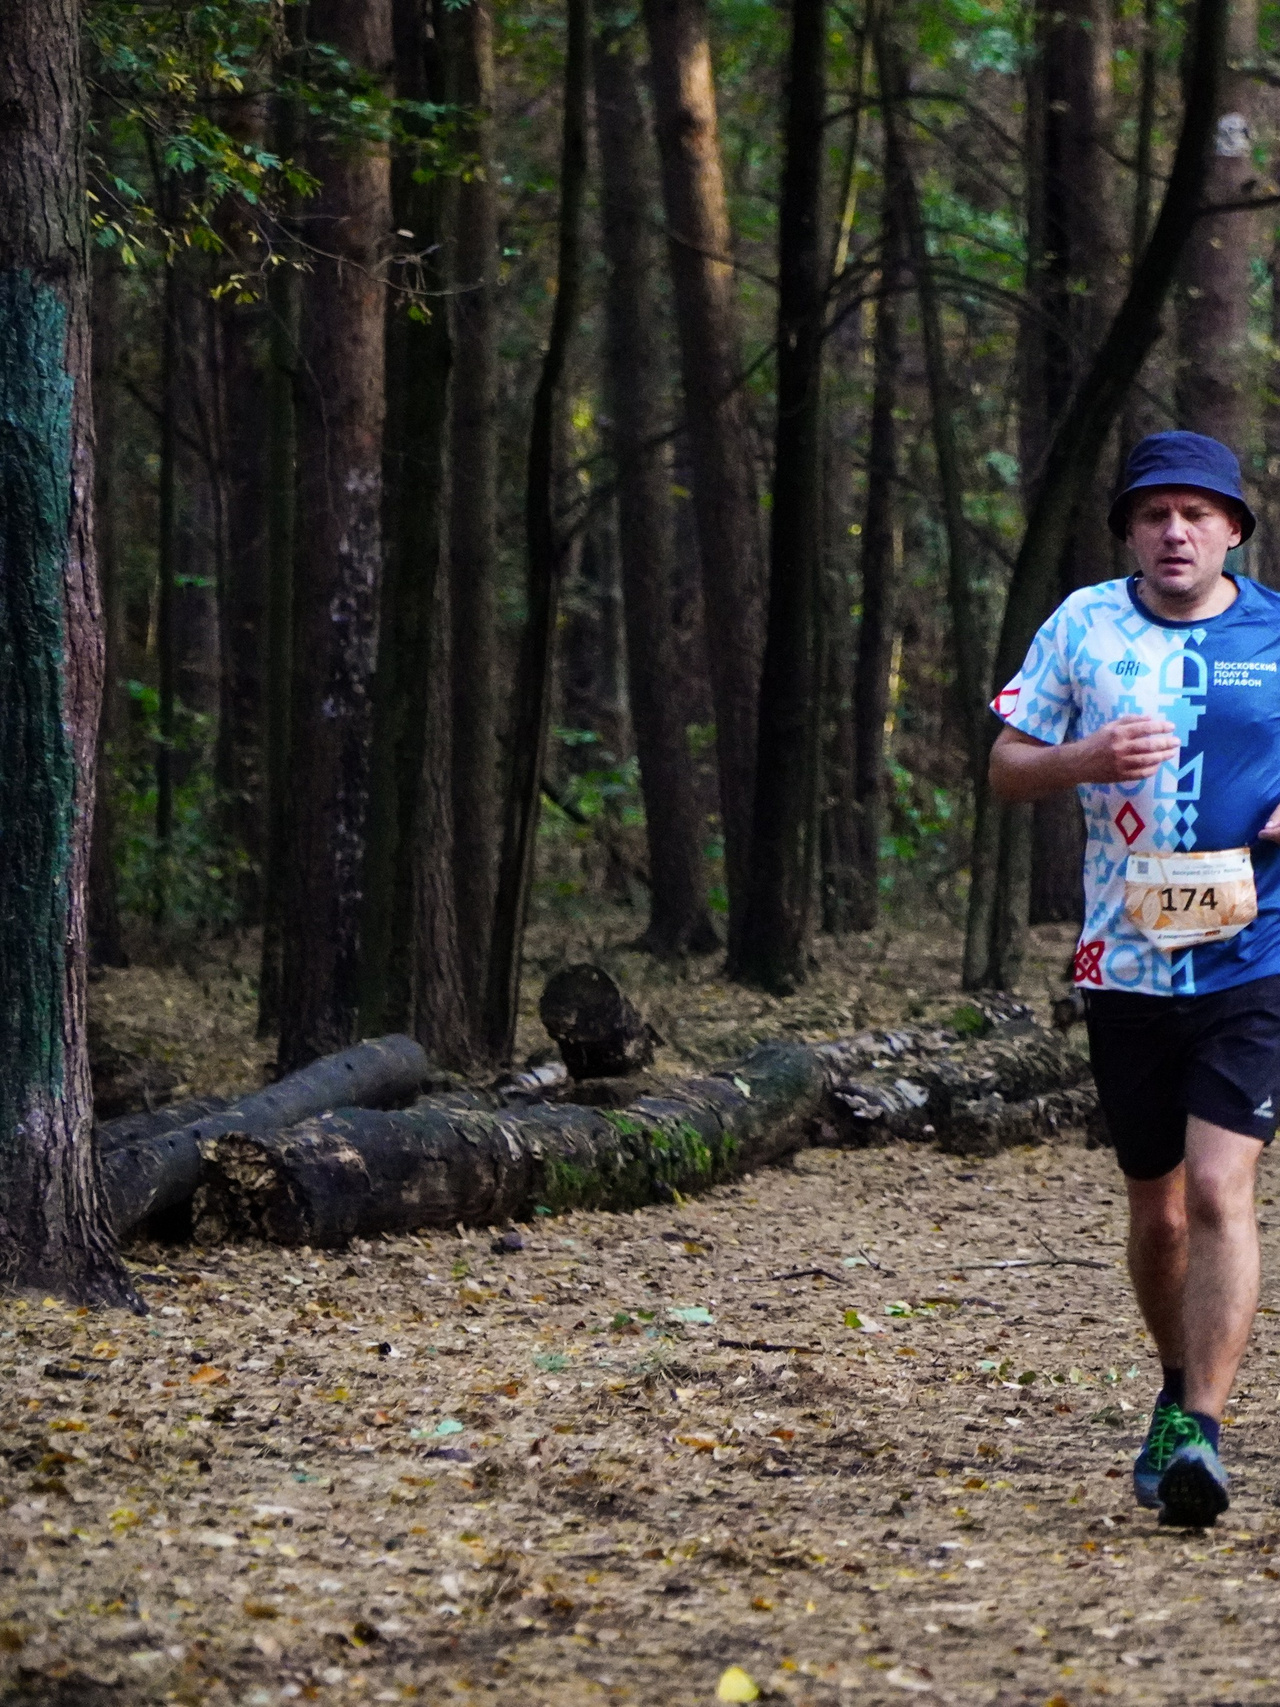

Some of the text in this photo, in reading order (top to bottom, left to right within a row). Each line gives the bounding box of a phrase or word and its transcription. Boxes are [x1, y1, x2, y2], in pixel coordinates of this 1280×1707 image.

[1213, 660, 1277, 672] МОСКОВСКИЙ
[1213, 670, 1242, 678] ПОЛУ
[1213, 678, 1262, 687] МАРАФОН
[1161, 887, 1219, 911] 174
